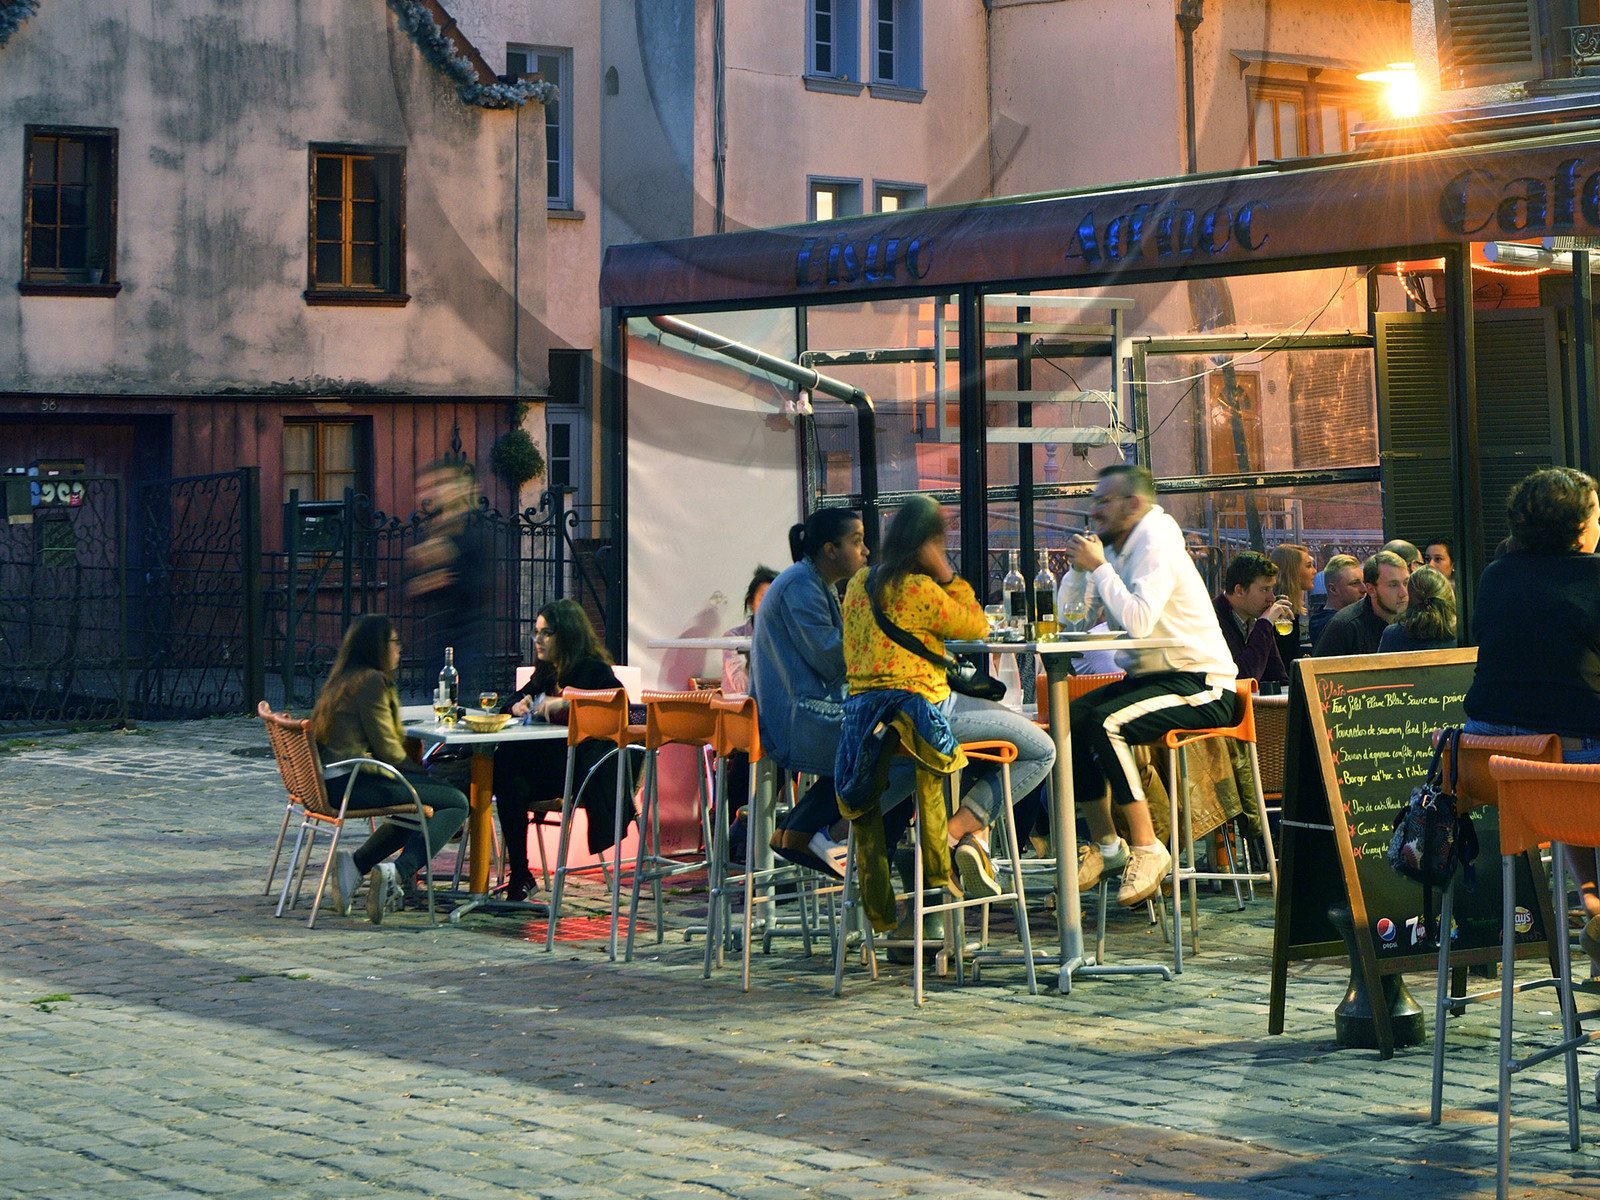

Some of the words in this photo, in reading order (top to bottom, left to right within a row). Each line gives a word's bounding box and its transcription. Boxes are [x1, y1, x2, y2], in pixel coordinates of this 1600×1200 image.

[796, 231, 933, 287] Bistro
[1367, 723, 1376, 736] de
[1365, 802, 1373, 813] de
[1381, 823, 1390, 832] de
